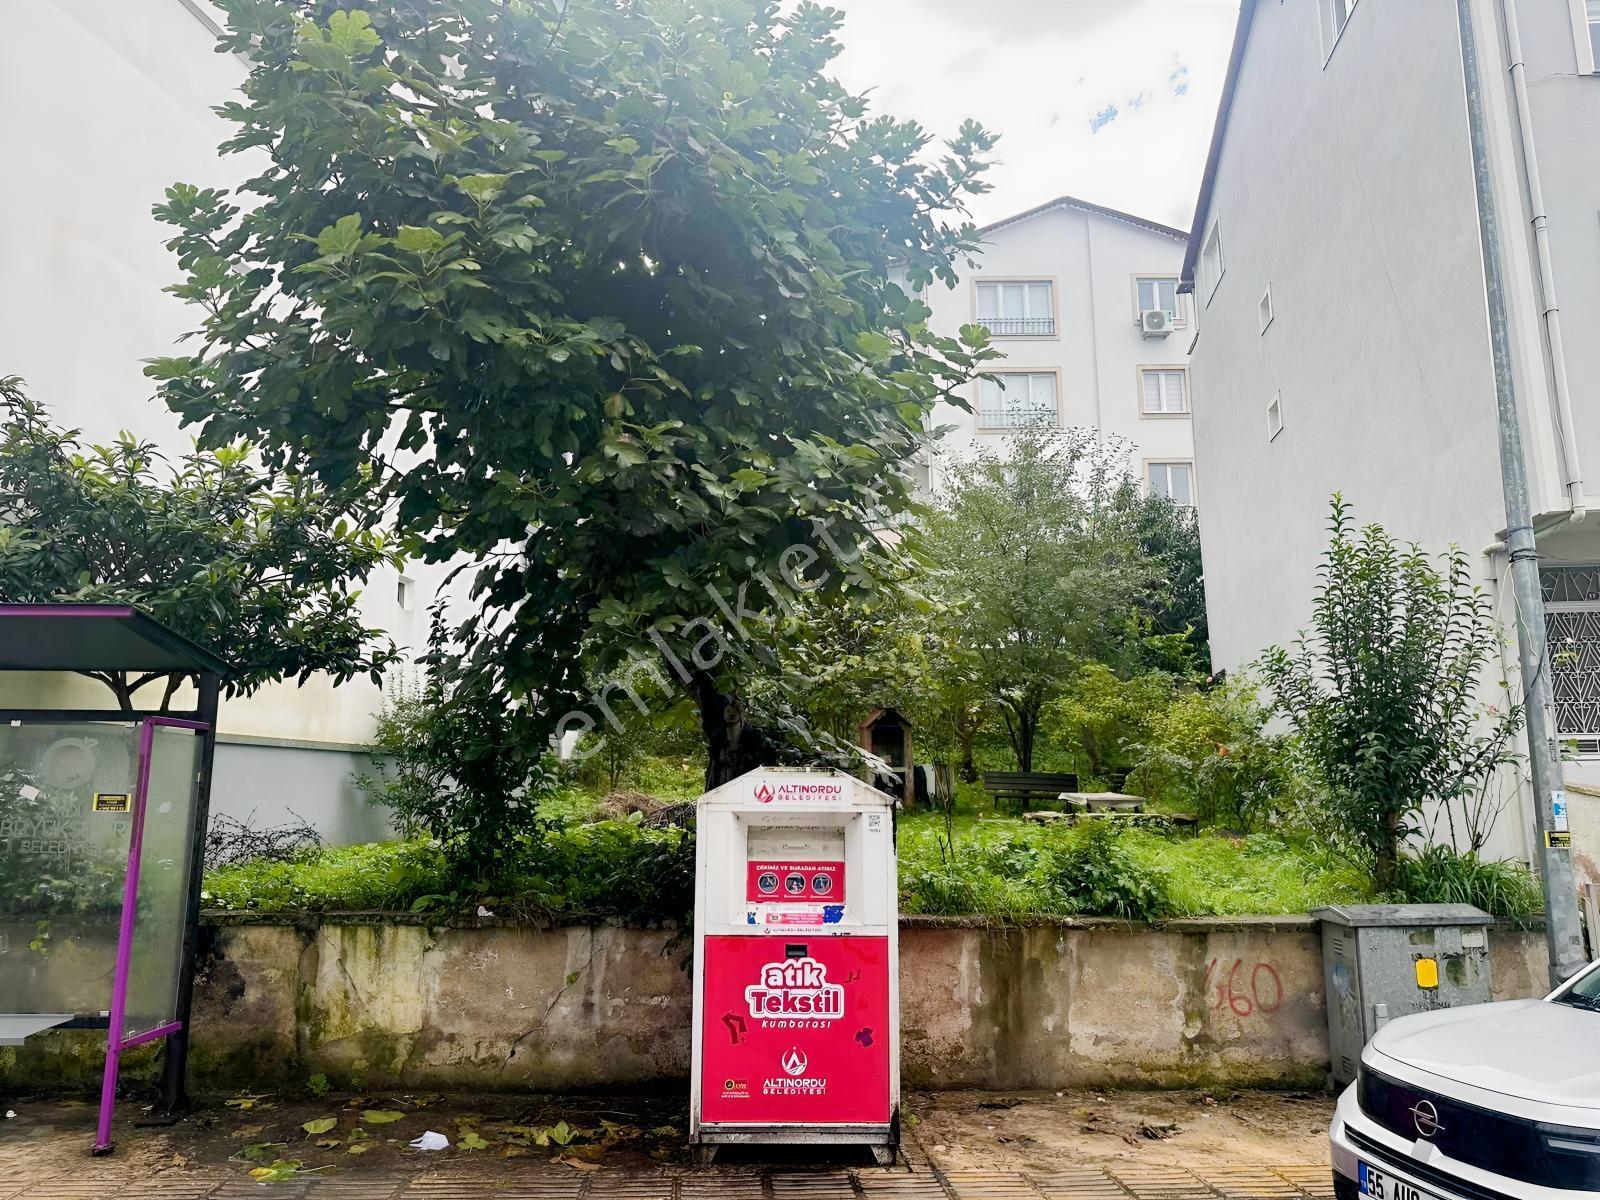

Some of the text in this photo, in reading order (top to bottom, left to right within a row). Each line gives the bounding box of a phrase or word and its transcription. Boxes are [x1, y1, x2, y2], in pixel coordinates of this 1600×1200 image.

[778, 784, 842, 794] ALTINORDU
[766, 962, 823, 989] atık
[751, 989, 839, 1013] Tekstil
[763, 1078, 827, 1088] ALTINORDU
[1367, 1169, 1385, 1200] 55
